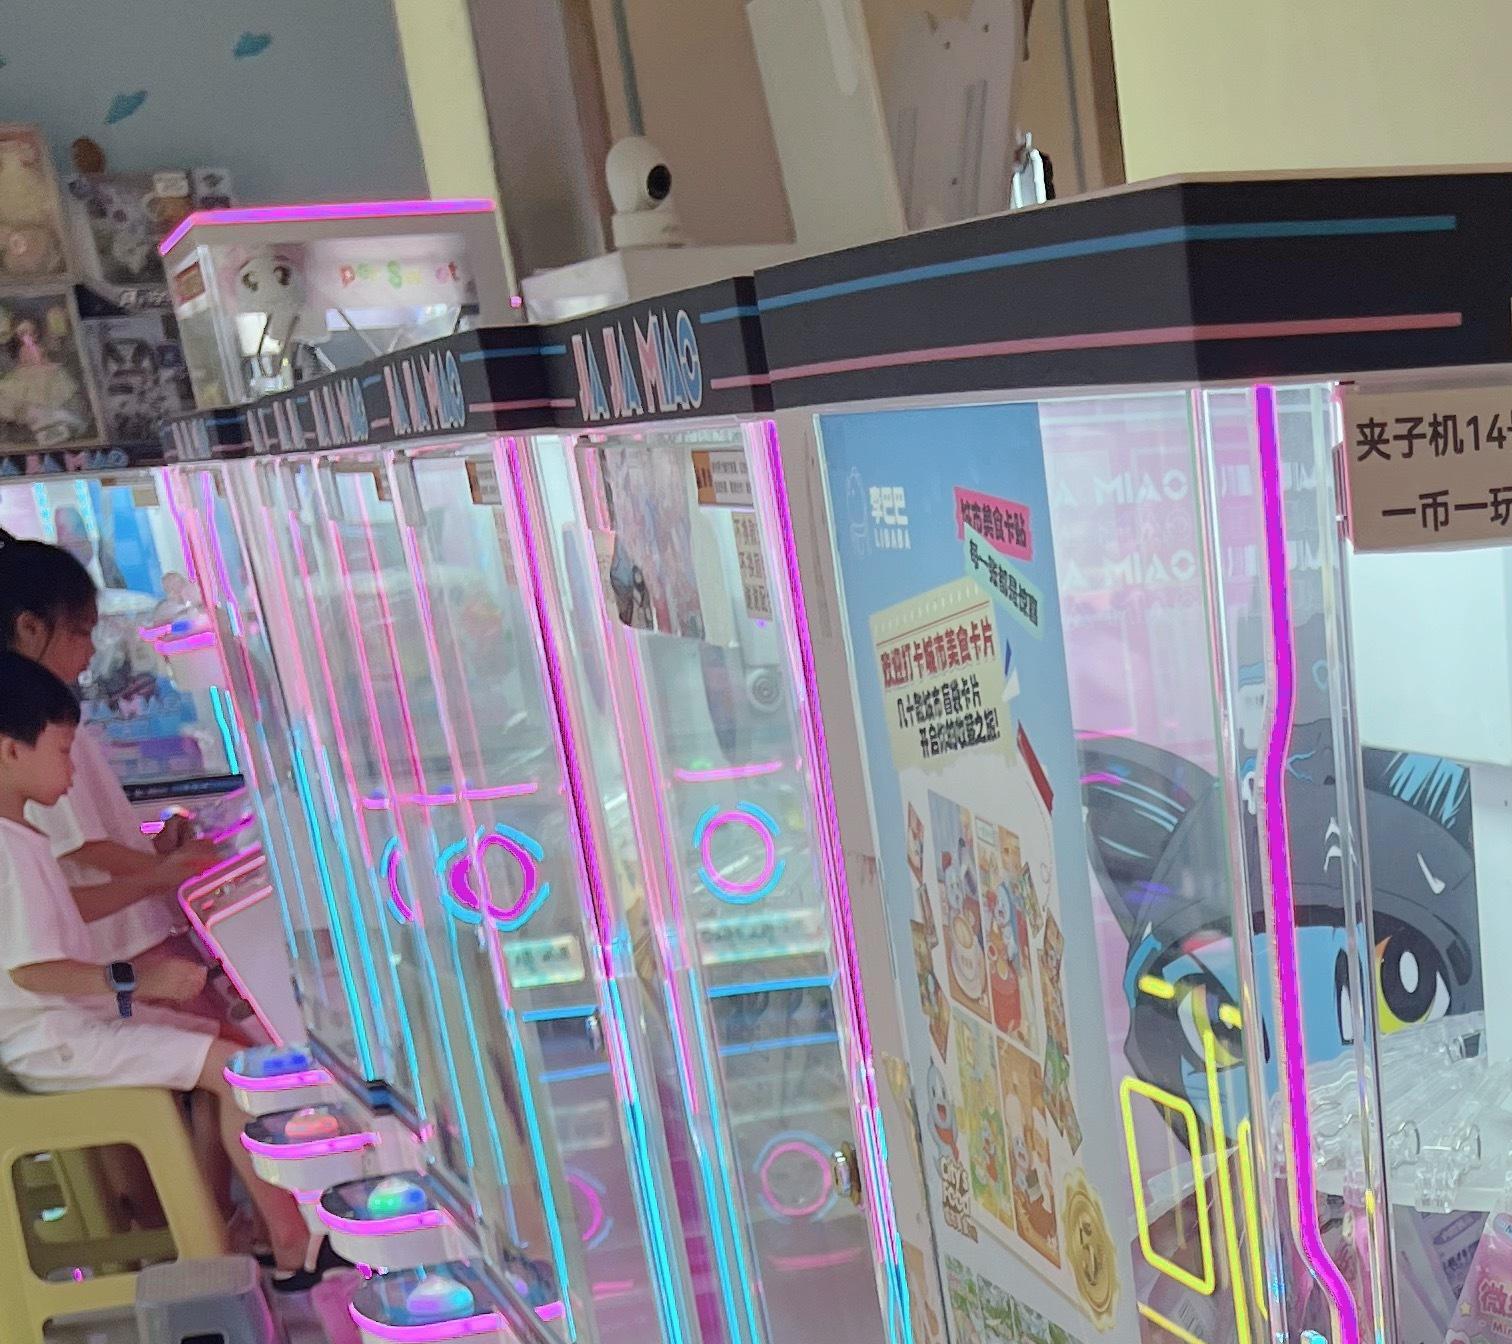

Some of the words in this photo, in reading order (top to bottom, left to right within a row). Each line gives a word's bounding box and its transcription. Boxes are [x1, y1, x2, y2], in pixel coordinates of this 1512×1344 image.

[572, 327, 611, 422] JIA
[602, 320, 644, 419] JIA
[633, 308, 702, 414] MIAO
[880, 616, 996, 688] 欢迎打卡城市美食卡片
